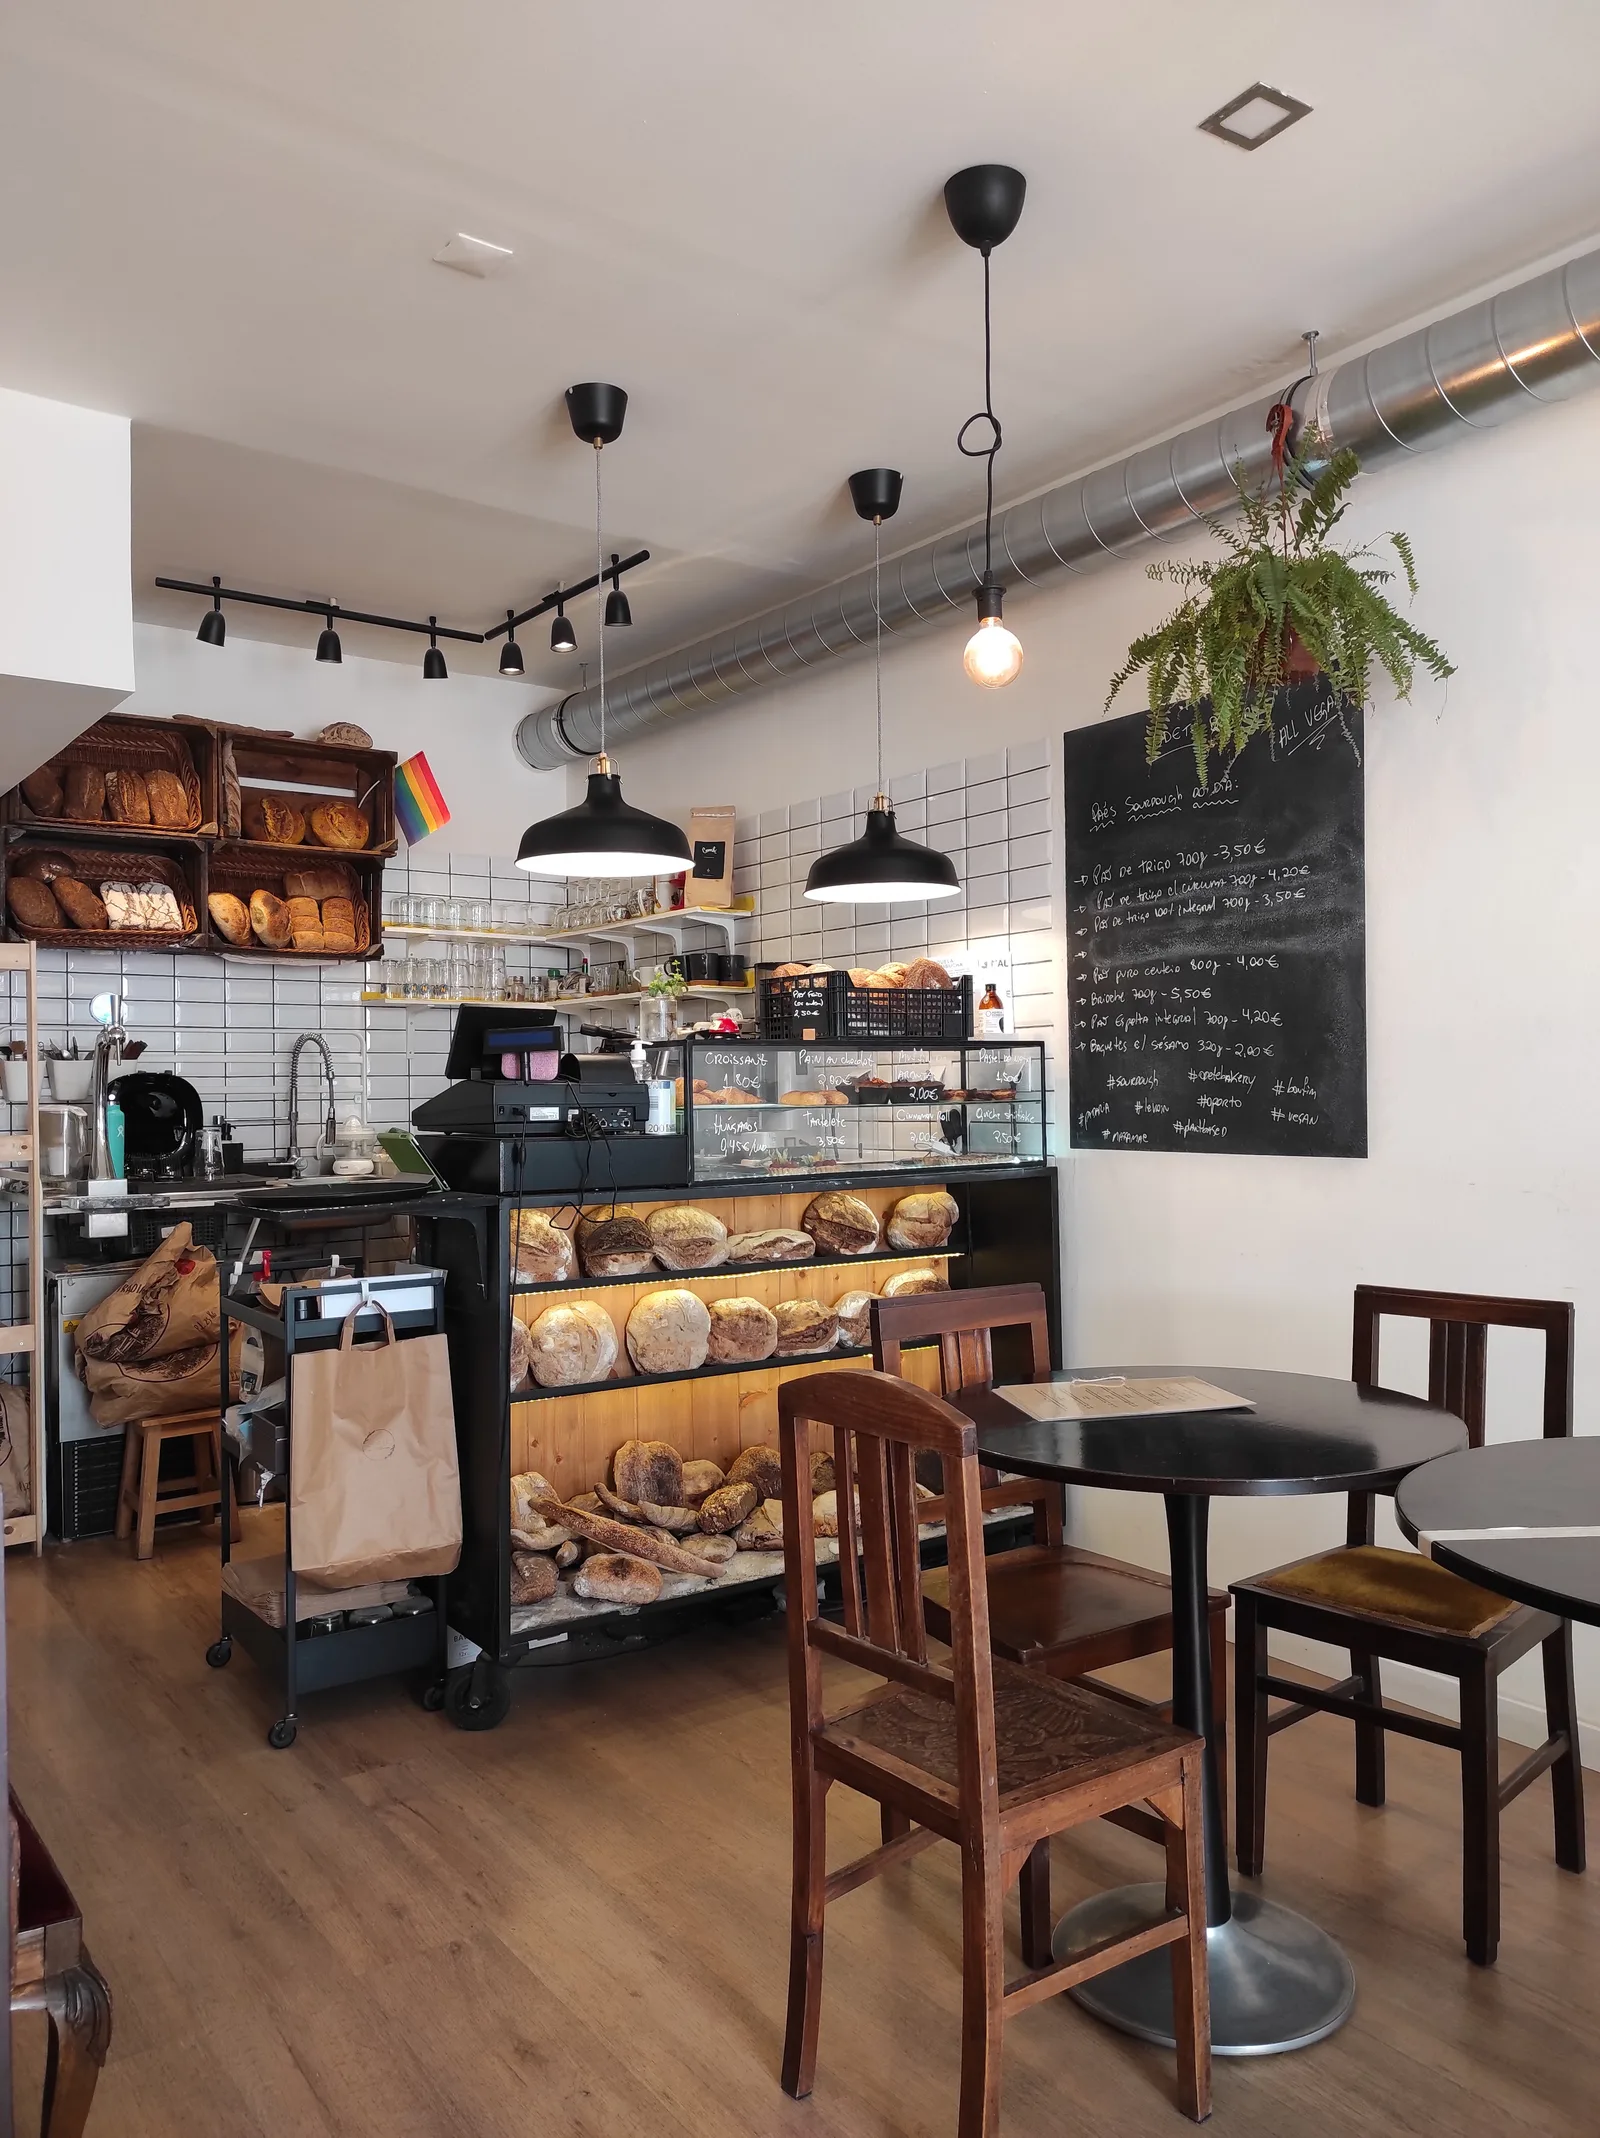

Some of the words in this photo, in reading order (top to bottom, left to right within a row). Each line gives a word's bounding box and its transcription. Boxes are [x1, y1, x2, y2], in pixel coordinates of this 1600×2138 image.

[1279, 720, 1300, 748] ALL
[1176, 851, 1208, 870] 700g
[1228, 873, 1258, 889] 700g
[1222, 897, 1251, 913] 700g
[1262, 887, 1306, 907] 3,50€
[1190, 958, 1221, 976] 800g
[1236, 954, 1280, 971] 4,00€
[1131, 988, 1157, 1005] 700g
[1170, 987, 1212, 1004] 5,50€
[1242, 1008, 1284, 1027] 4,20€
[1197, 1039, 1224, 1058] 320g
[909, 1086, 939, 1101] 2,00€
